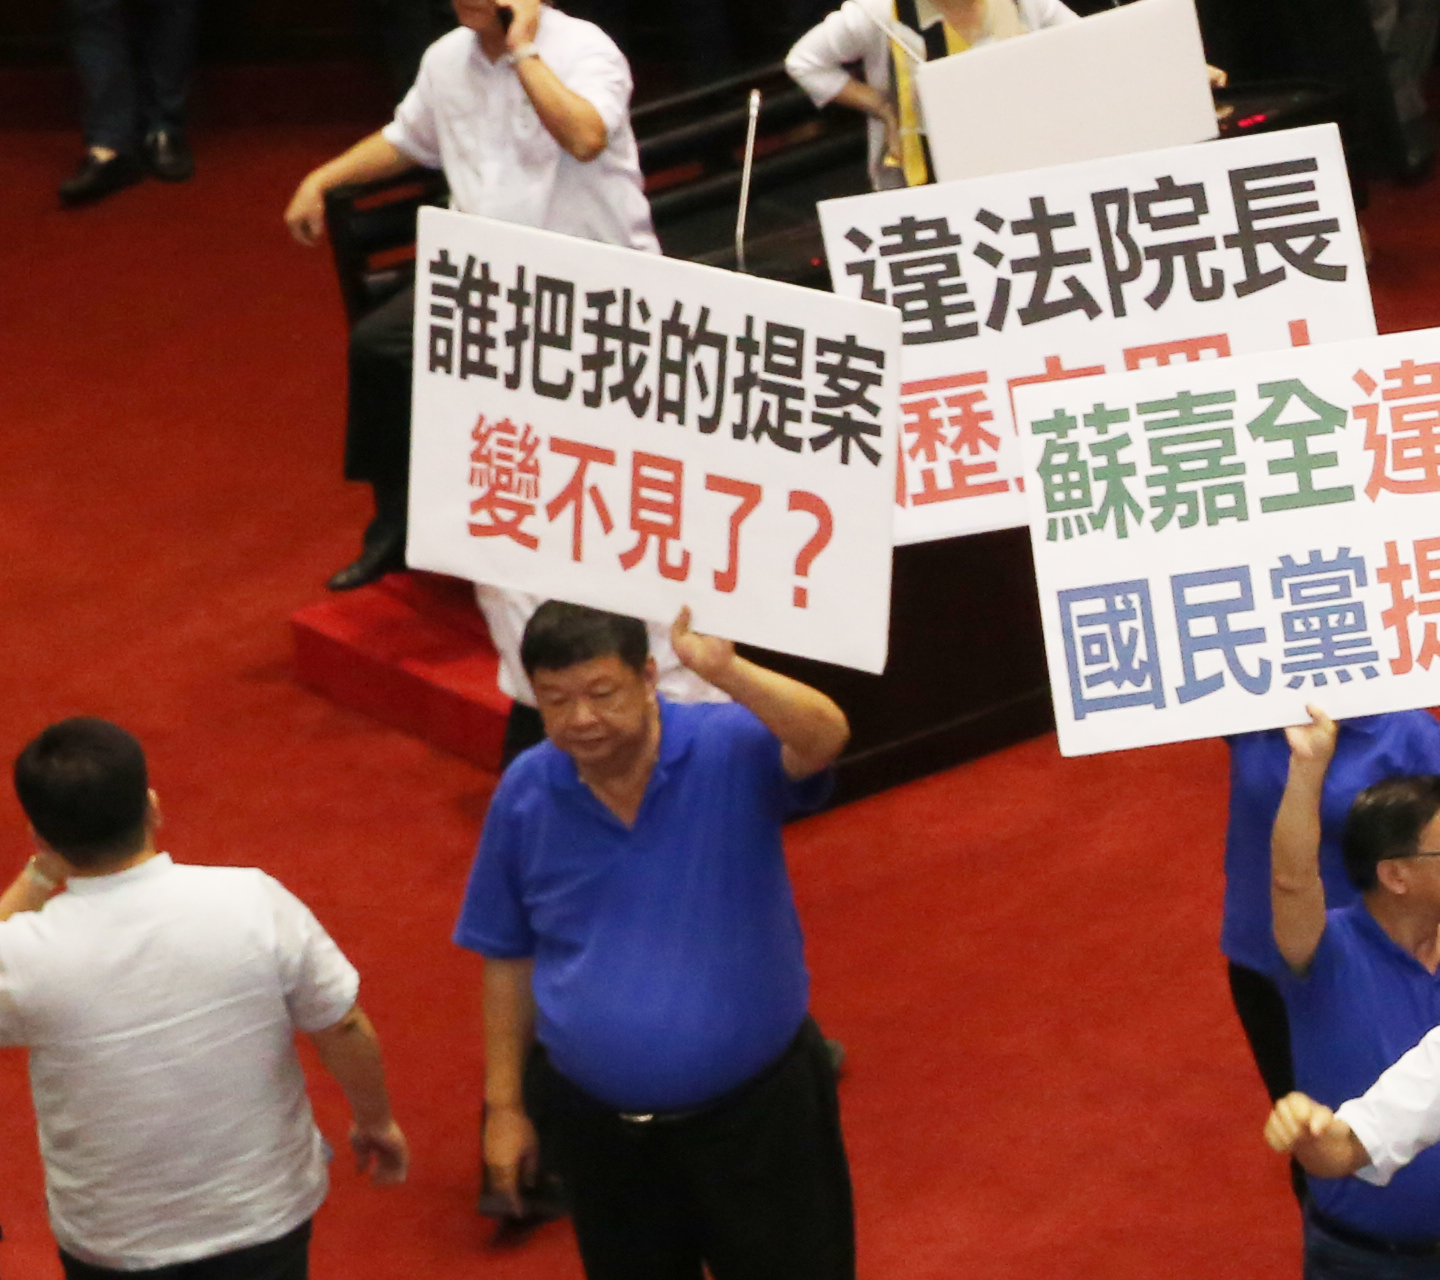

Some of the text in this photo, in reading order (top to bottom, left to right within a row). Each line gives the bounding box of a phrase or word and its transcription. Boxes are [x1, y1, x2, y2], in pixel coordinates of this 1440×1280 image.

[844, 157, 1348, 346] 違法院長
[427, 250, 887, 468] 誰把我的提案
[467, 411, 834, 610] 變不見了？
